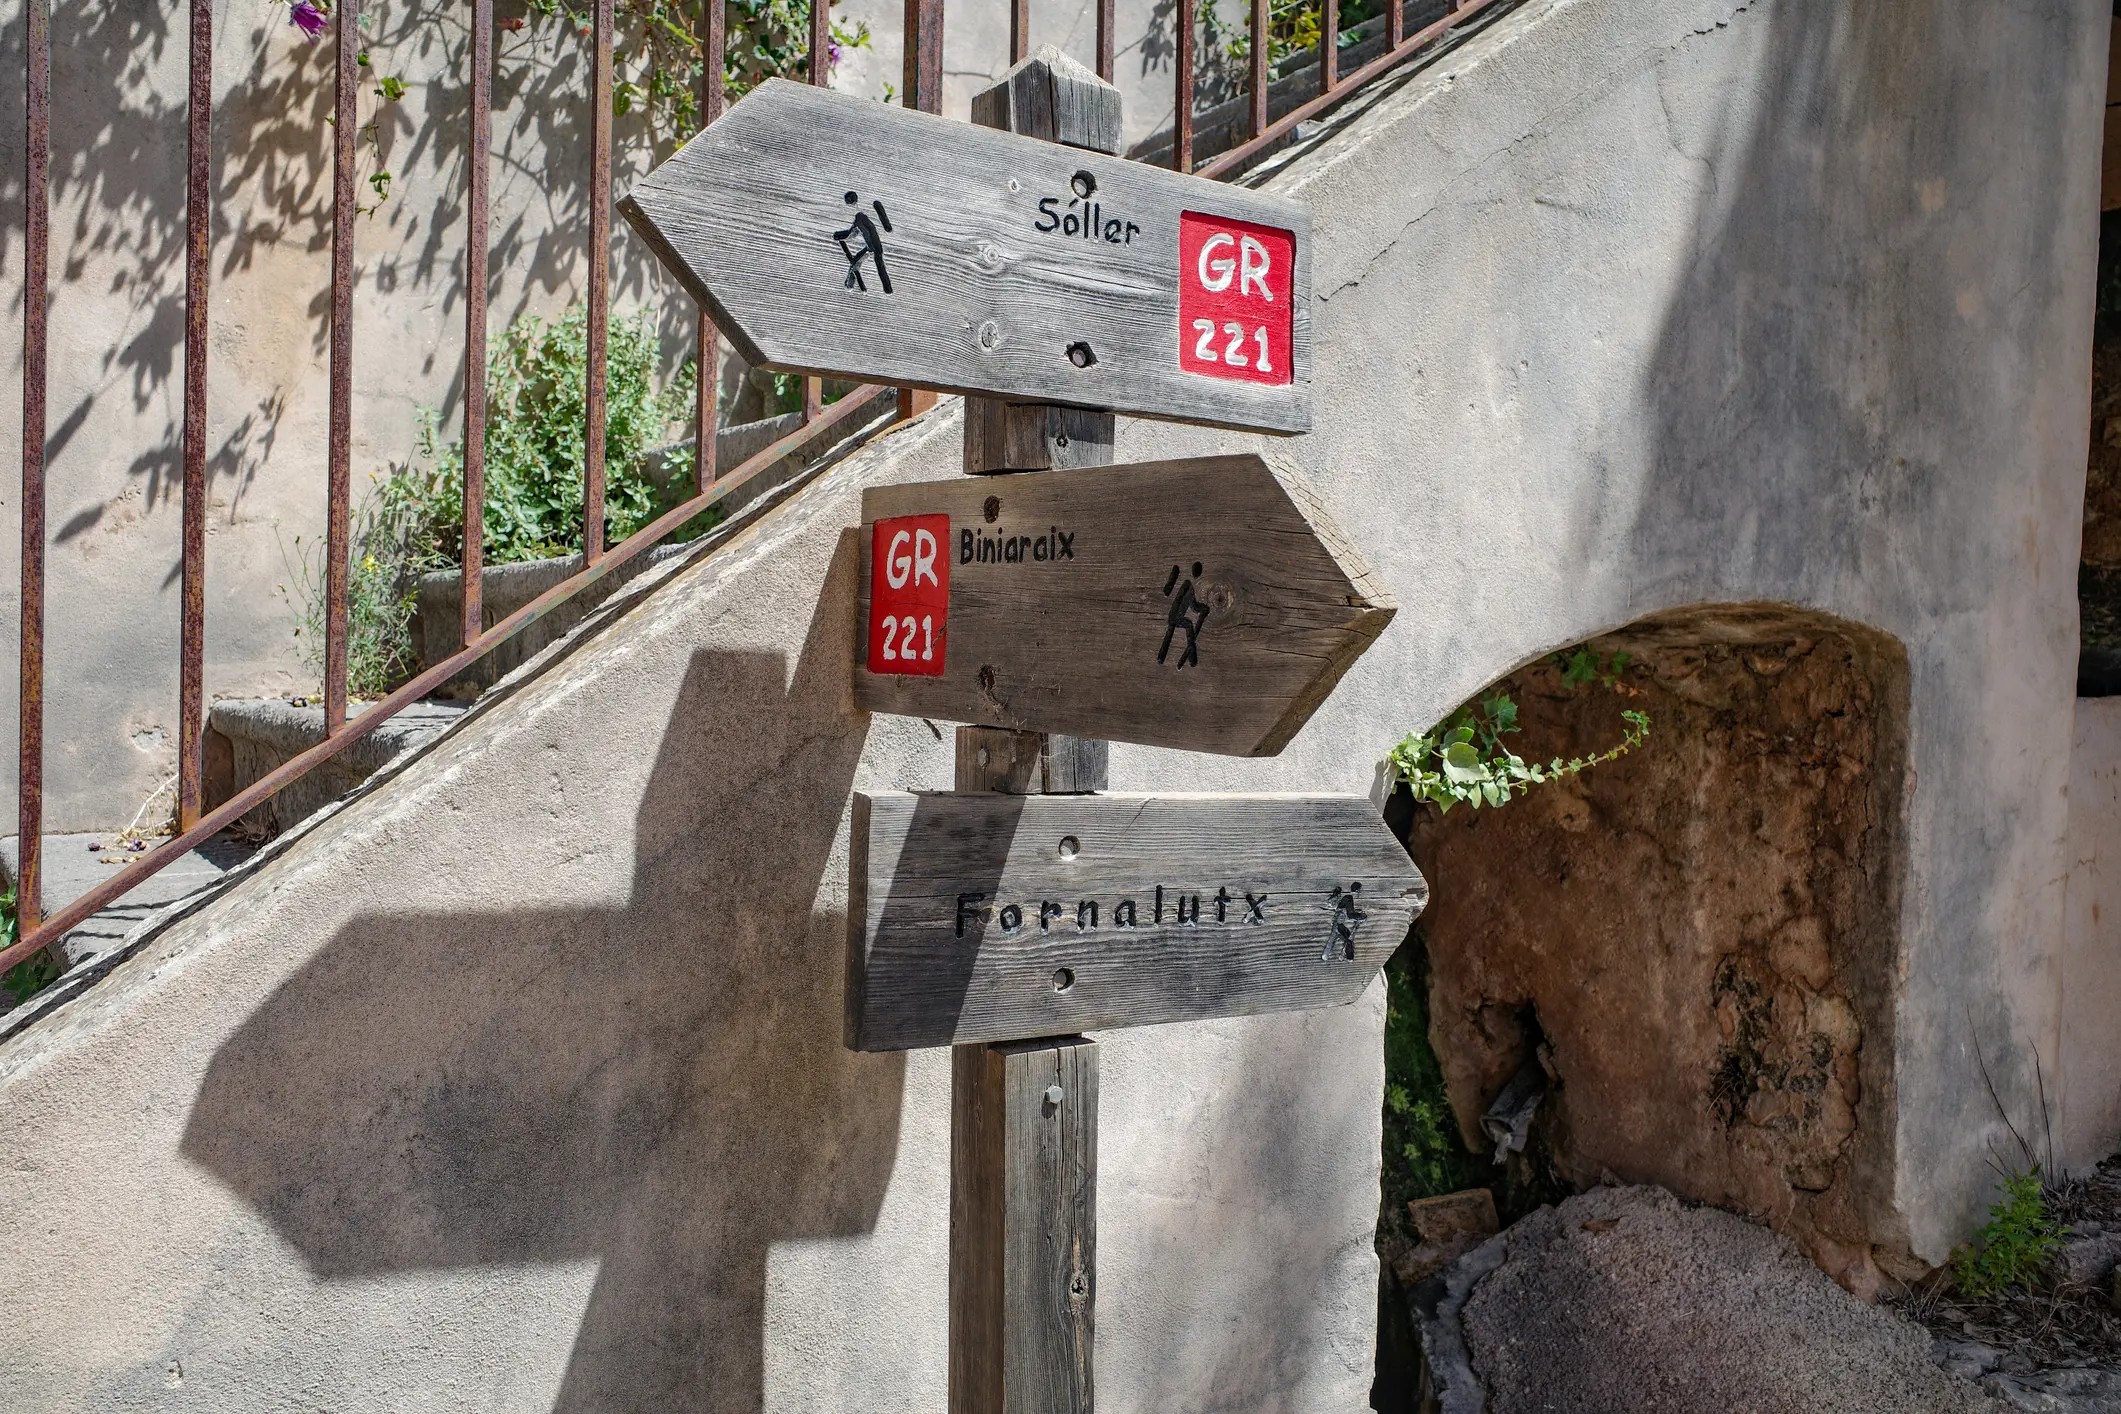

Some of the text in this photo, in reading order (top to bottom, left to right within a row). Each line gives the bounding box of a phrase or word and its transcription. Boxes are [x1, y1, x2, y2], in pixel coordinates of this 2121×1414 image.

[1034, 197, 1140, 247] Sóller
[1198, 232, 1274, 302] GR
[1193, 318, 1273, 372] 221
[886, 528, 939, 590] GR
[960, 526, 1075, 565] Biniaraix
[881, 614, 934, 661] 221
[955, 884, 1268, 939] Fornalutx
